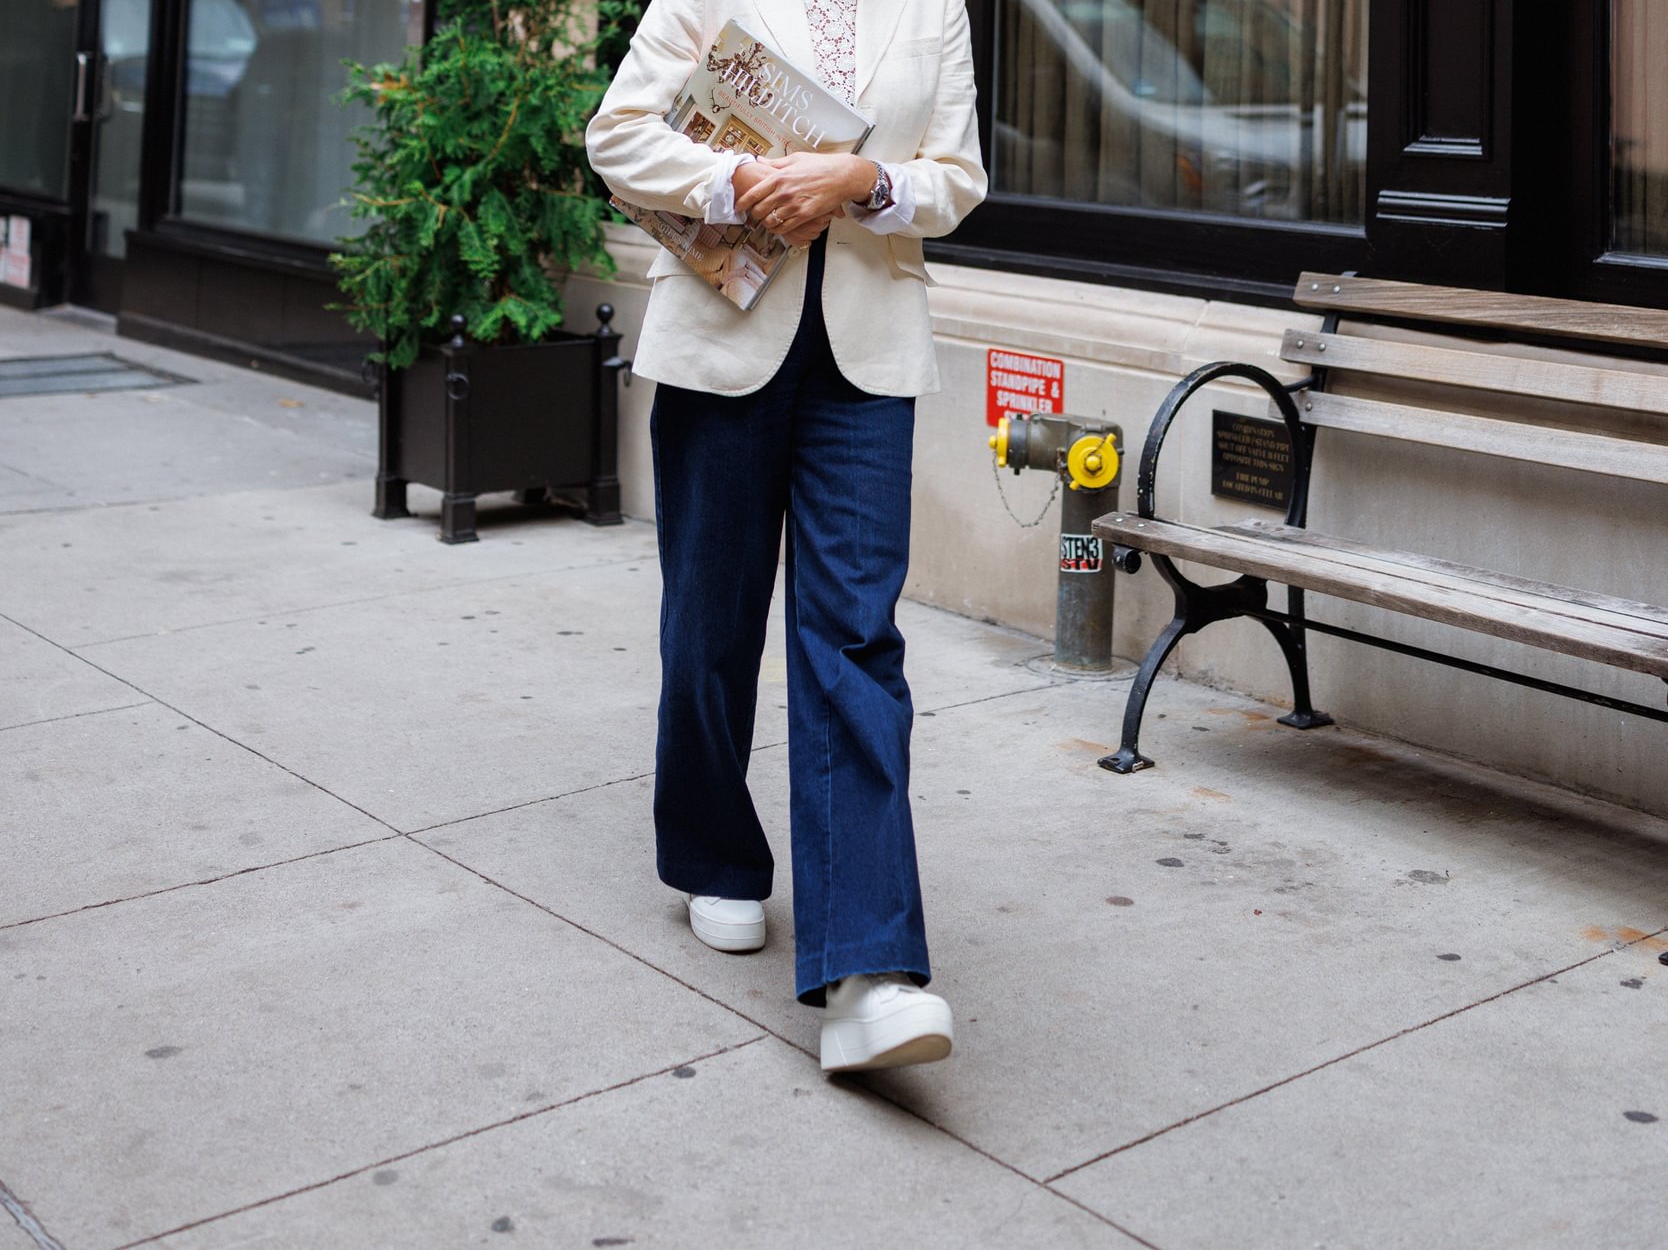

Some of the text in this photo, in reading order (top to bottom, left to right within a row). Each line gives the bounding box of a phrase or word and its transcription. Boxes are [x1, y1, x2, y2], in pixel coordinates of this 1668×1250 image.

[759, 61, 813, 111] SIMS
[719, 90, 753, 119] BEAUTIFULLY
[754, 117, 776, 137] BRITISH
[722, 62, 825, 149] HILDITCH
[990, 351, 1061, 380] COMBINATION
[990, 370, 1060, 398] STANDPIPE &
[996, 390, 1053, 414] SPRINKLER
